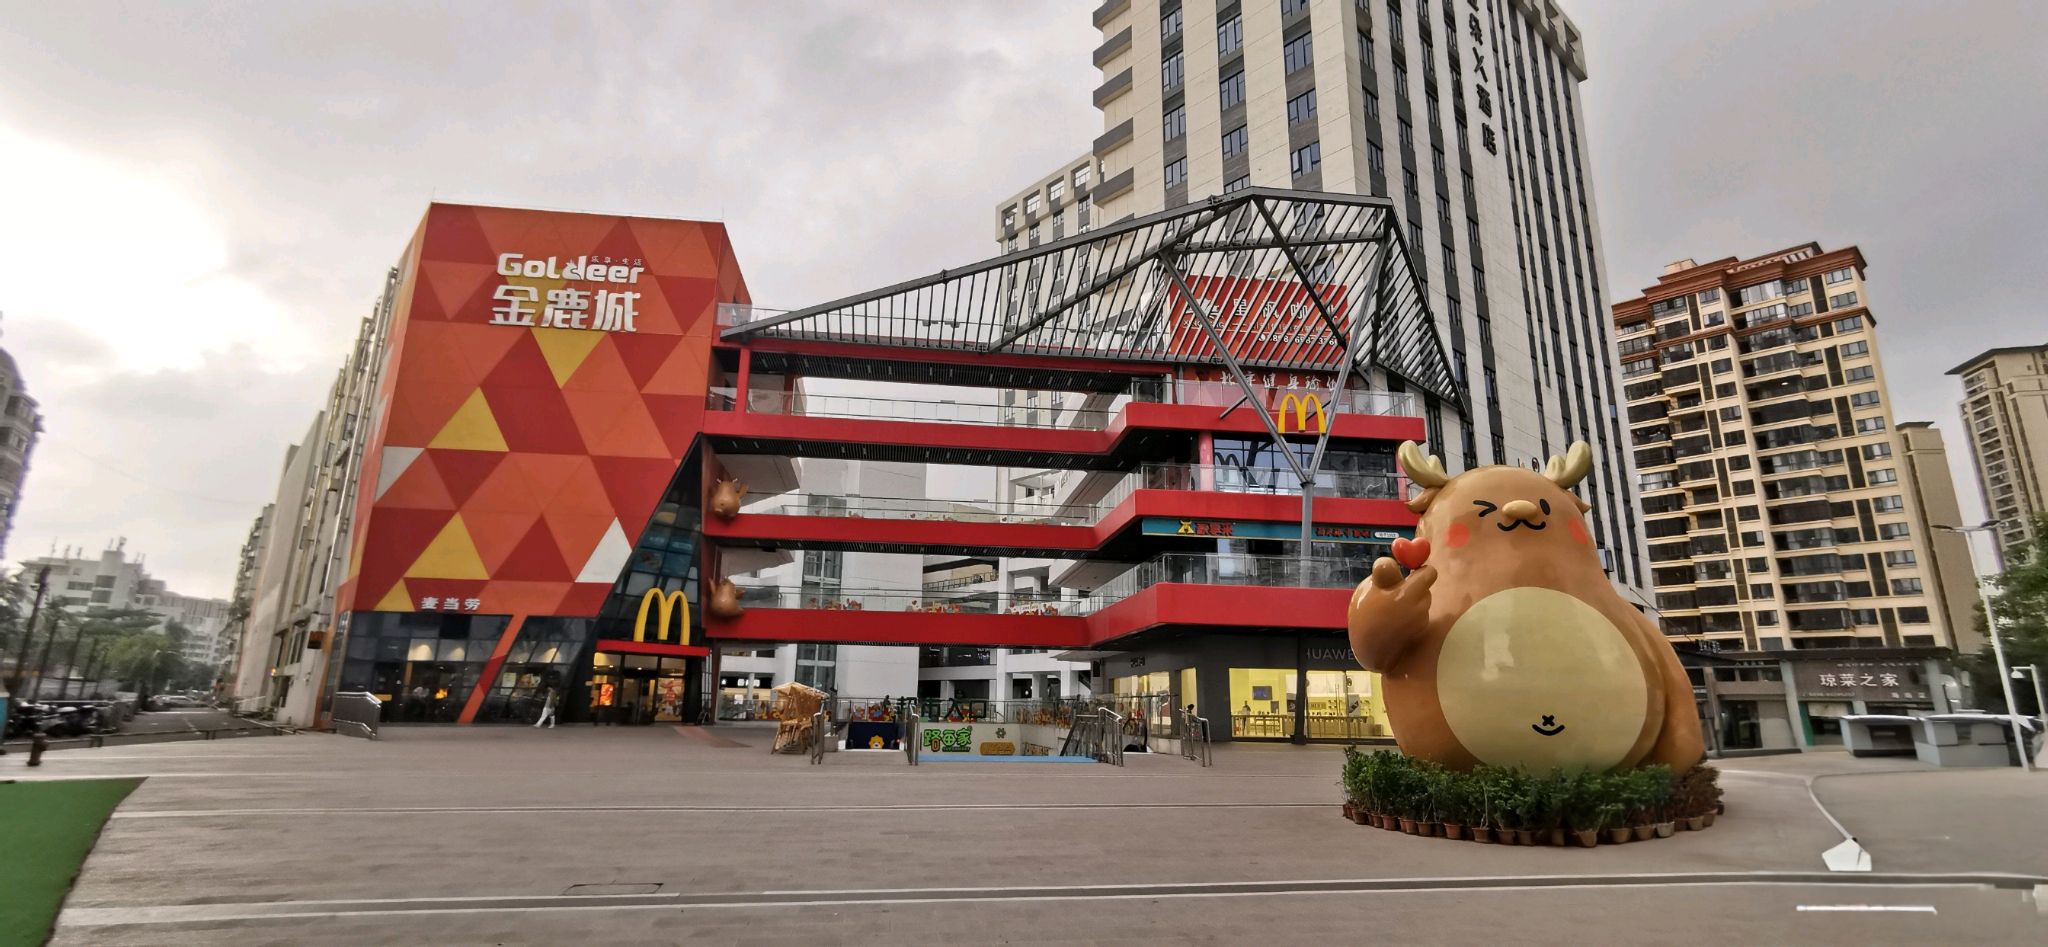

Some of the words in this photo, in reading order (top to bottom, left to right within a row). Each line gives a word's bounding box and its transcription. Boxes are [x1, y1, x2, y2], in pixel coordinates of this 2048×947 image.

[497, 252, 645, 284] Goldeer
[489, 284, 641, 332] 金鹿城
[420, 596, 481, 611] 麦当劳
[1306, 648, 1354, 660] HUAWE
[1818, 672, 1900, 687] 琼菜之家
